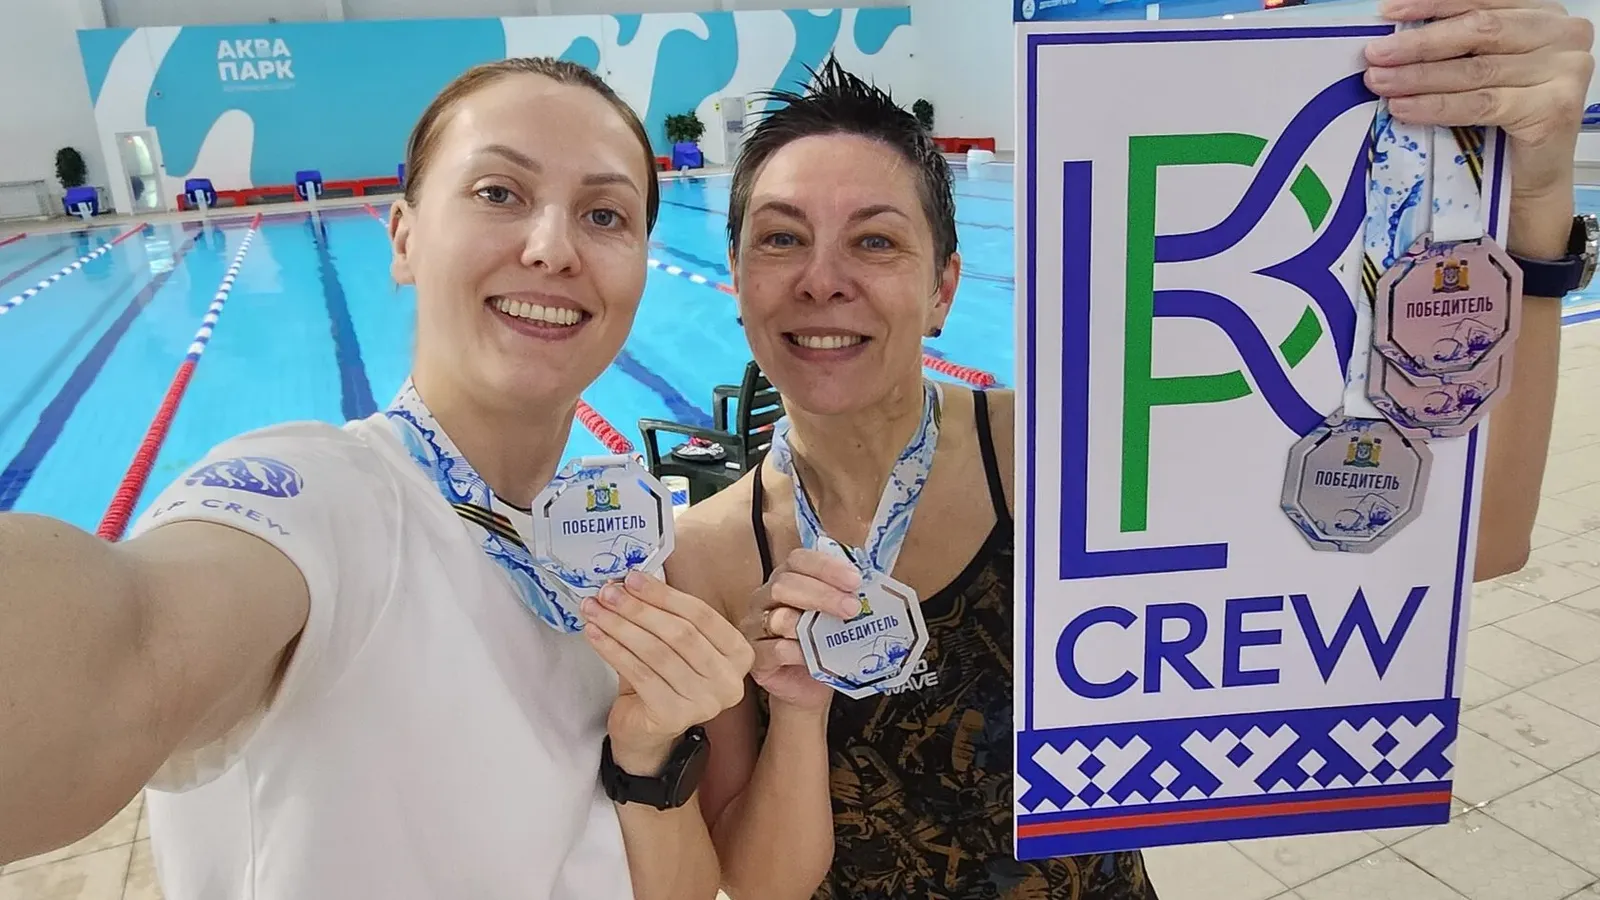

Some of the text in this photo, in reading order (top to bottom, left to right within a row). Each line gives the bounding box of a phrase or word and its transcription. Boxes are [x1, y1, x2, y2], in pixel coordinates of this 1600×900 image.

[217, 38, 291, 59] АКВА
[218, 60, 295, 81] ПАРК
[1406, 296, 1494, 319] ПОБЕДИТЕЛЬ
[1315, 470, 1400, 490] ПОБЕДИТЕЛЬ
[201, 499, 291, 535] CREW
[562, 515, 647, 535] ПОБЕДИТЕЛЬ
[825, 615, 899, 648] ПОБЕДИТЕЛЬ
[1055, 585, 1430, 699] CREW
